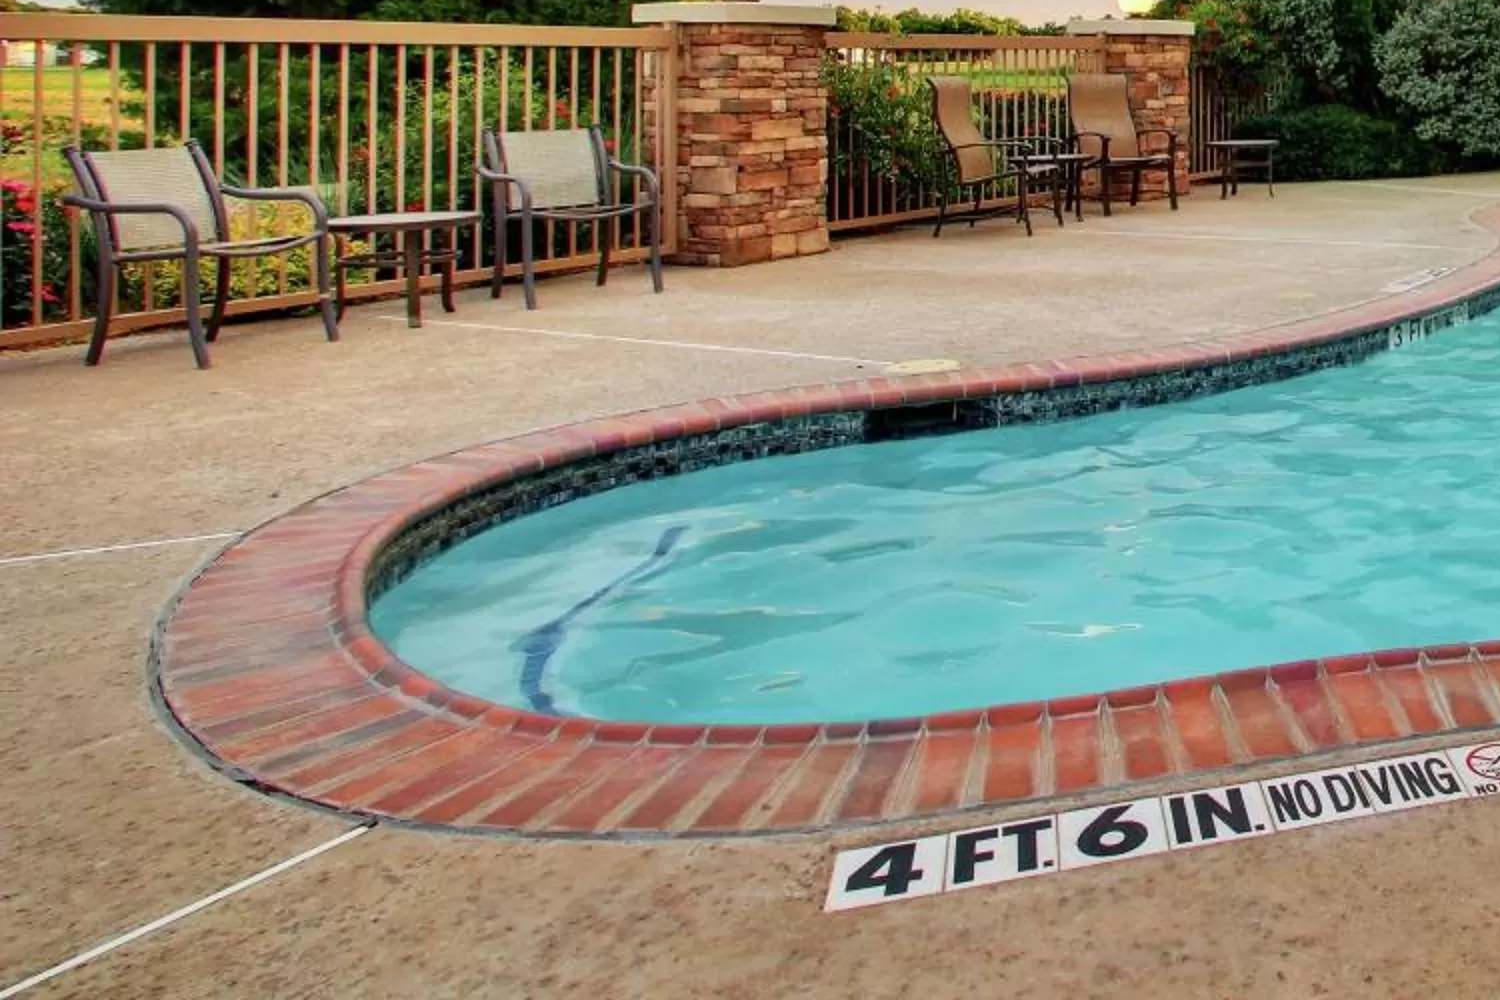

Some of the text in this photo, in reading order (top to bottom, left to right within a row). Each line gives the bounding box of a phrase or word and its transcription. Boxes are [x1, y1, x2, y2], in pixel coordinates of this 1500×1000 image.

[1394, 324, 1403, 347] 3
[1474, 782, 1498, 795] NO
[844, 757, 1462, 896] 4 FT. 6 IN. NO DIVING
